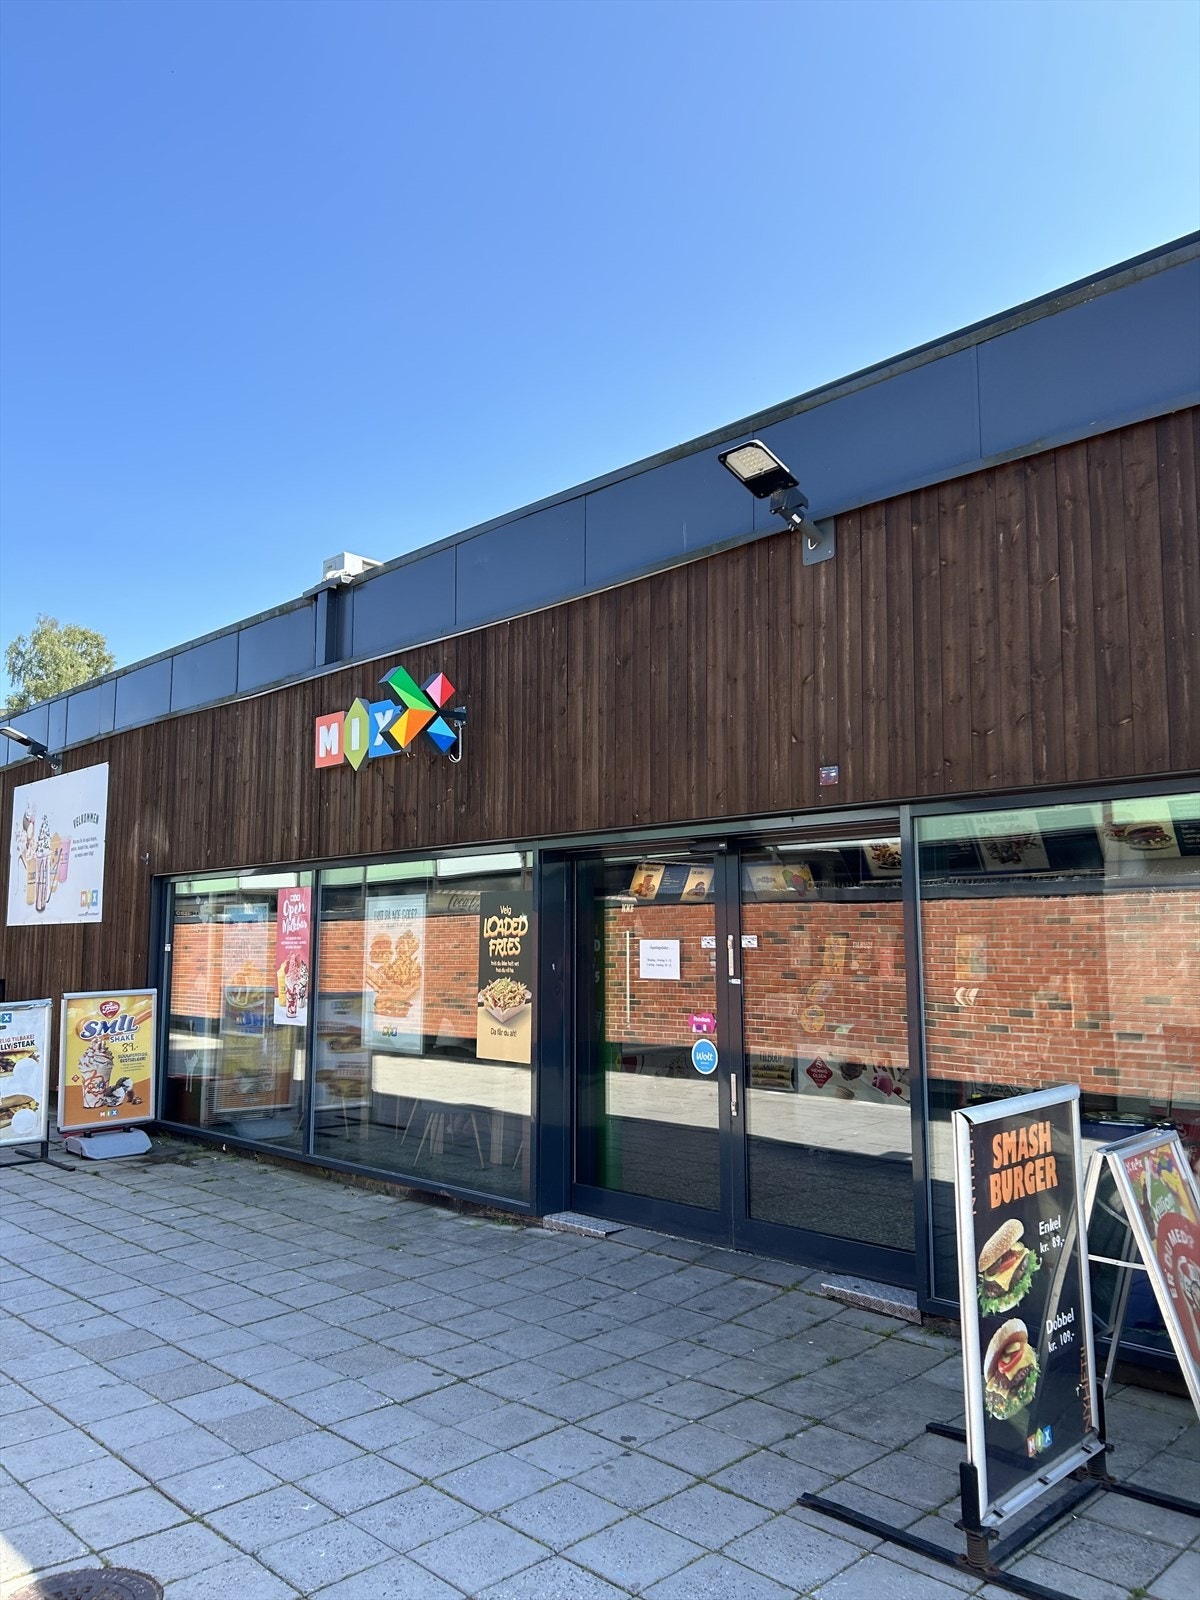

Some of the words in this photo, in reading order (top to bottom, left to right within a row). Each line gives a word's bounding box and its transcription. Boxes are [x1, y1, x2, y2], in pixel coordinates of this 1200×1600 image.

[73, 812, 100, 829] VELKOMMEN
[283, 899, 306, 920] Open
[500, 905, 512, 916] Velg
[483, 914, 529, 938] LOADED
[489, 937, 521, 958] FRIES
[80, 1014, 139, 1039] SMIL
[13, 1039, 35, 1049] STEAK
[110, 1033, 135, 1043] SHAKE
[696, 1051, 714, 1062] Wolt
[992, 1120, 1052, 1169] SMASH
[989, 1155, 1059, 1209] BURGER
[1038, 1214, 1062, 1236] Enkel
[1040, 1241, 1050, 1254] kr.
[1051, 1234, 1066, 1250] 89,-
[1046, 1307, 1075, 1334] Dobbel
[1048, 1340, 1058, 1353] kr.
[1059, 1329, 1076, 1346] 109,-
